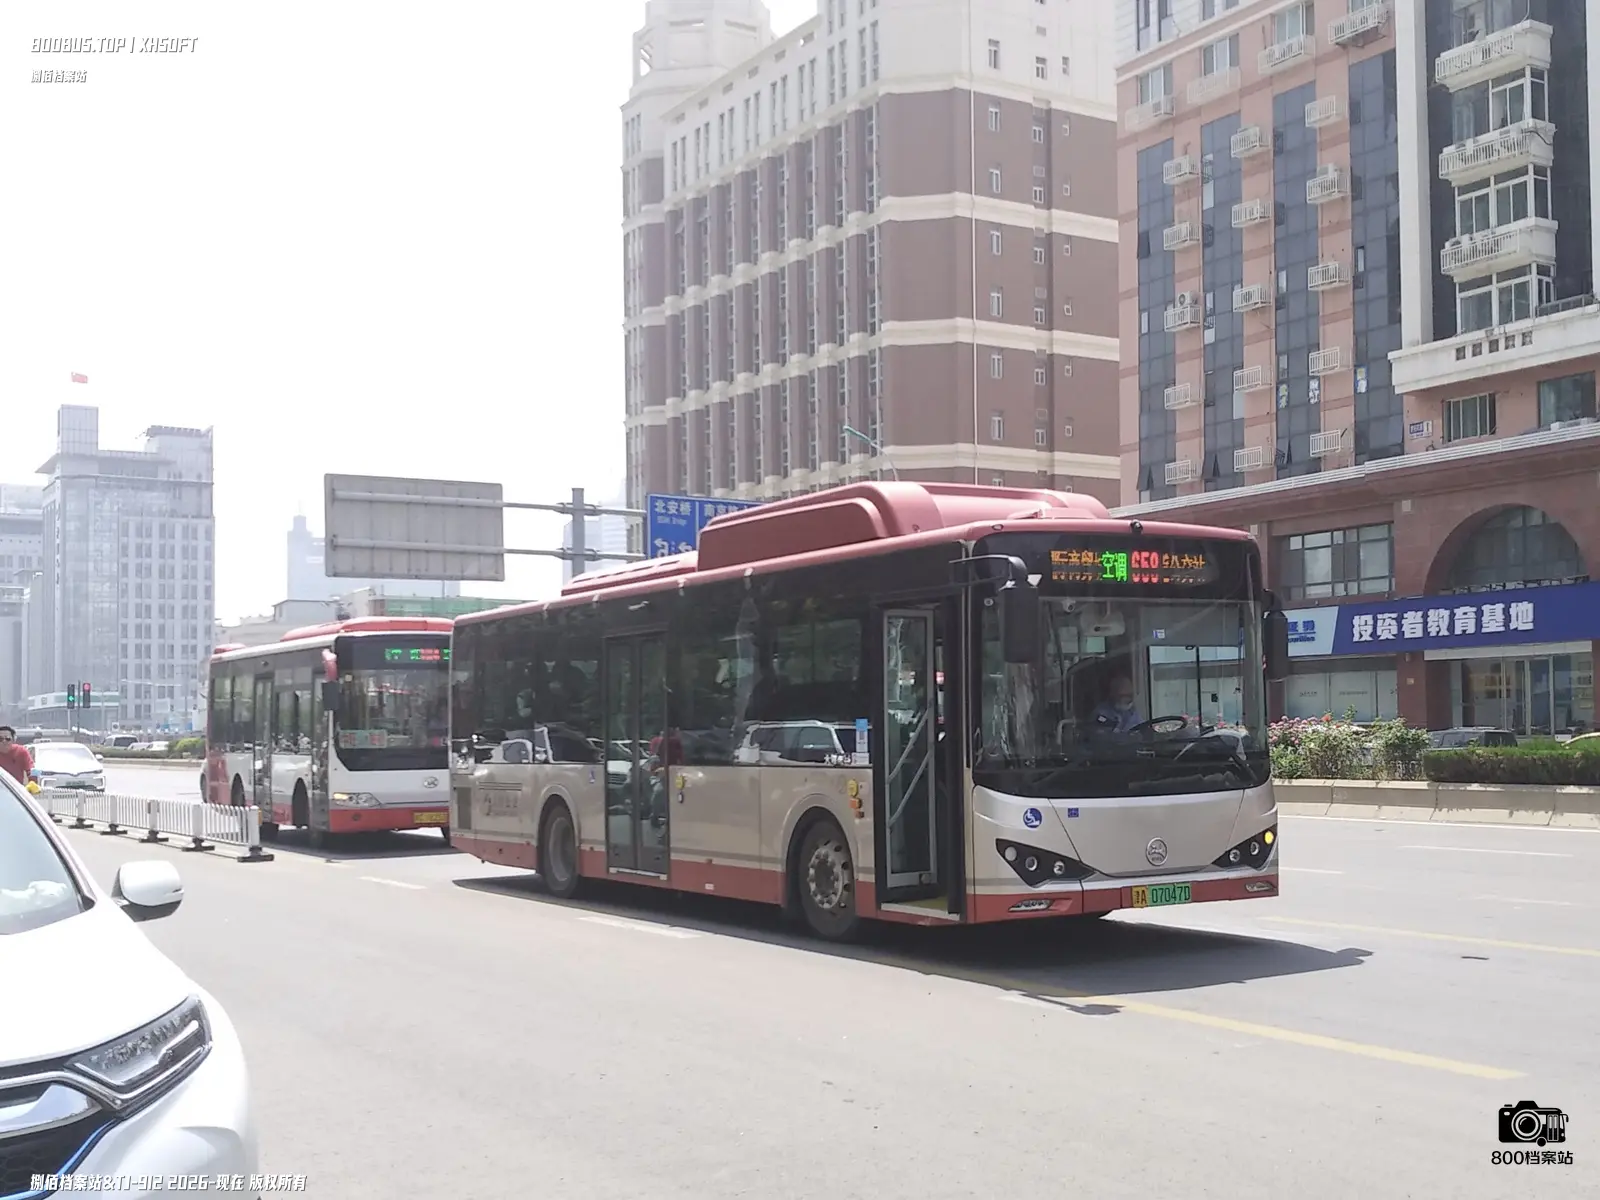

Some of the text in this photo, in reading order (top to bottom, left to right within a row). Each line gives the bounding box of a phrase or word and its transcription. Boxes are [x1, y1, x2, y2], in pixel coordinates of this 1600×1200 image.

[654, 499, 692, 516] 北安桥
[1101, 551, 1128, 582] 空调
[1352, 601, 1535, 642] 投资者教育基地
